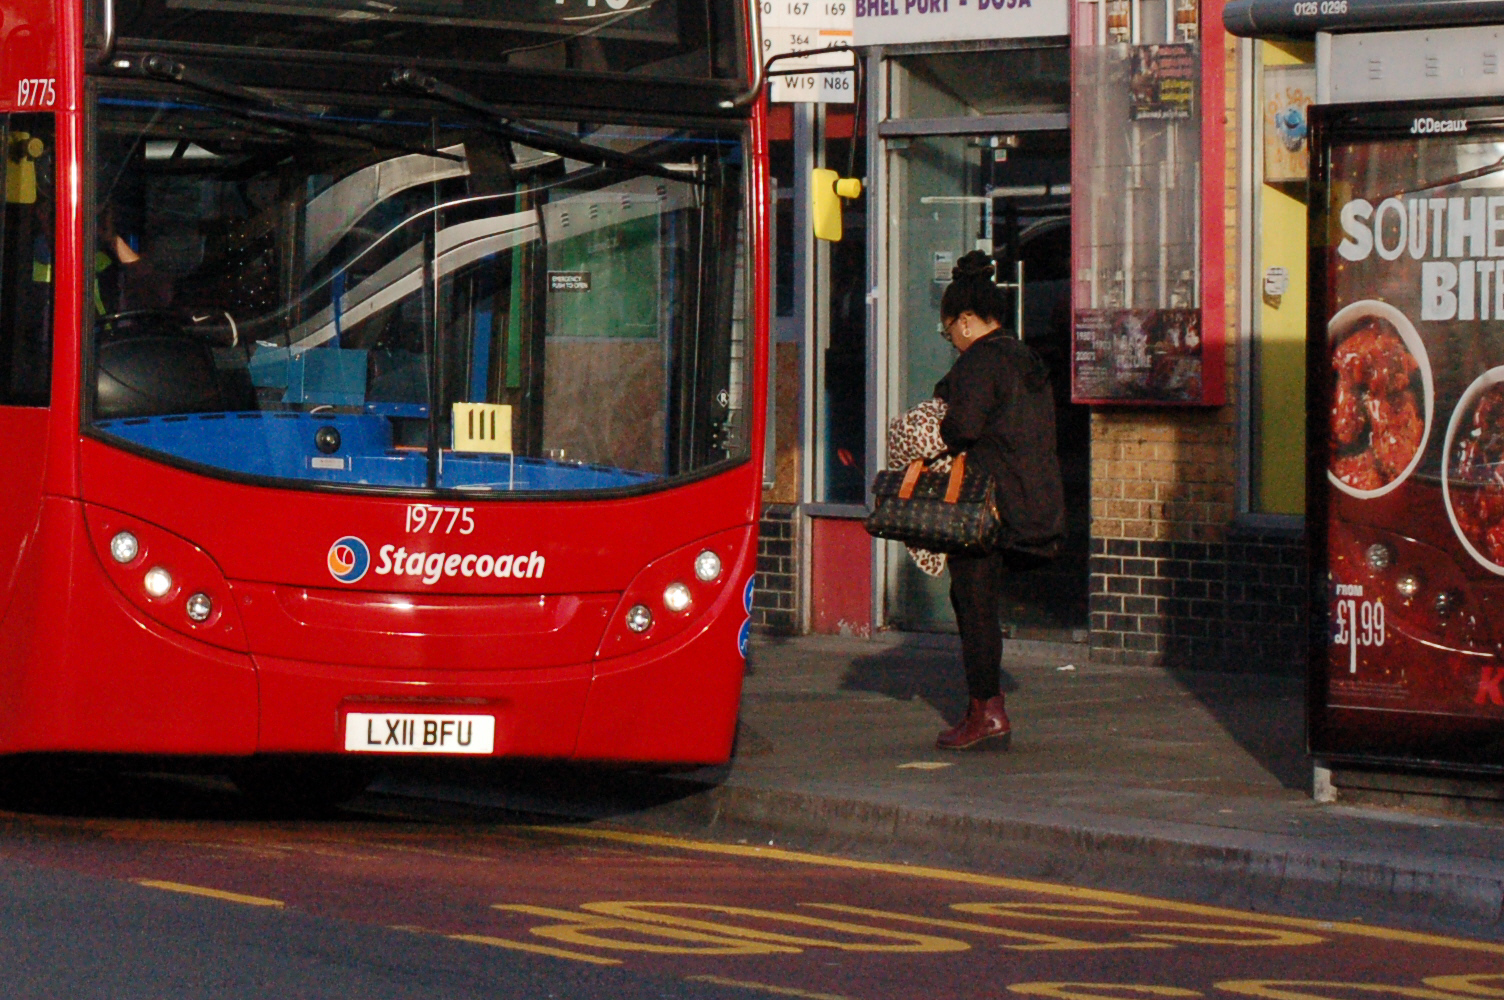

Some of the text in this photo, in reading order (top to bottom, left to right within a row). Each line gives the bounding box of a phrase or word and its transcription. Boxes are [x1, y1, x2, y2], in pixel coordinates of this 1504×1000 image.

[787, 3, 809, 15] 167
[825, 3, 846, 15] 169
[1294, 2, 1318, 15] 0126
[790, 34, 809, 45] 364
[17, 78, 56, 106] 19775
[785, 76, 815, 94] W19
[823, 77, 849, 95] N86
[1410, 118, 1467, 134] JCDecaux
[468, 408, 496, 440] 111
[406, 505, 475, 535] 19775
[375, 544, 546, 585] Stagecoach
[1336, 584, 1363, 596] FROM
[1334, 600, 1385, 673] £1.99
[367, 719, 472, 747] LX11 BFU
